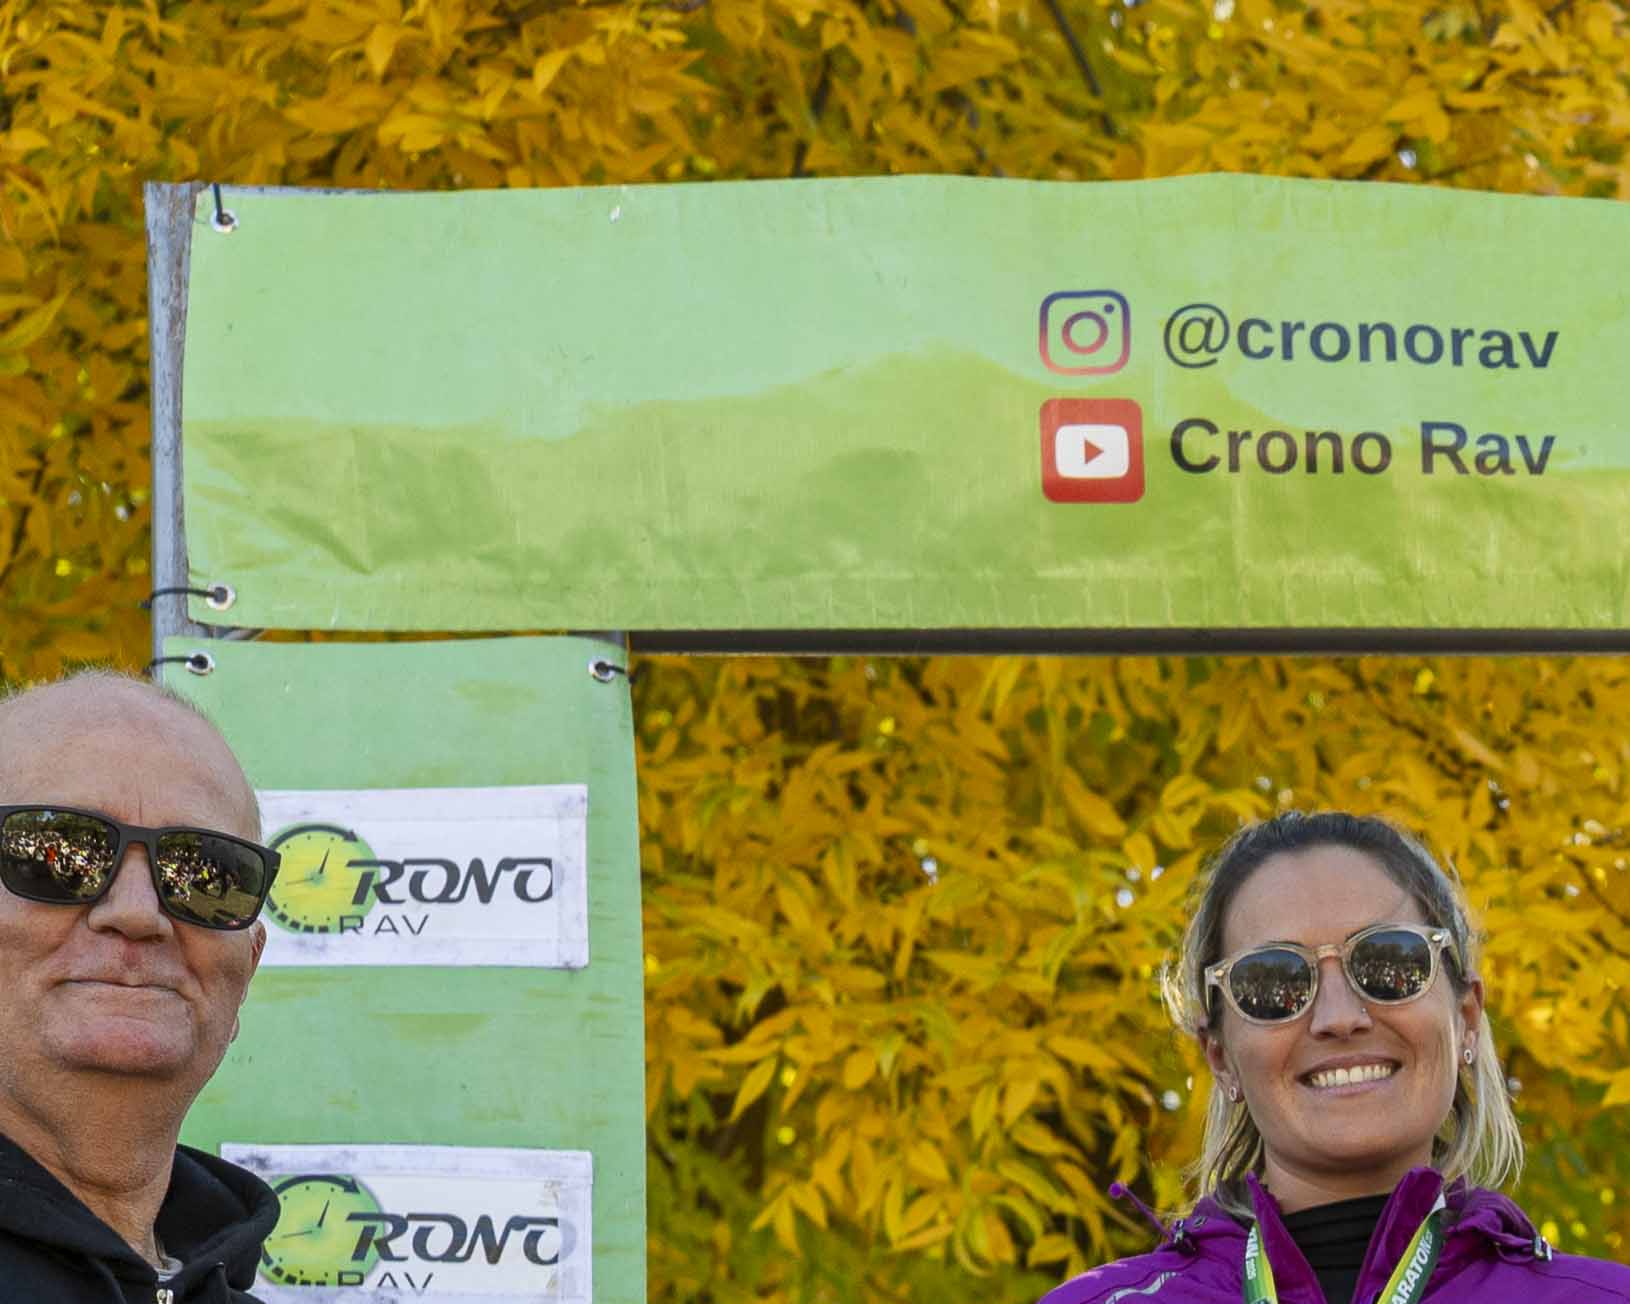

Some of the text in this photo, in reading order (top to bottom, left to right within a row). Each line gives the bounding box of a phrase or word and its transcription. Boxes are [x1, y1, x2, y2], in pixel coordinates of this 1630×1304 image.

[1162, 303, 1559, 370] @cronorav
[1169, 417, 1556, 476] Crono Rav
